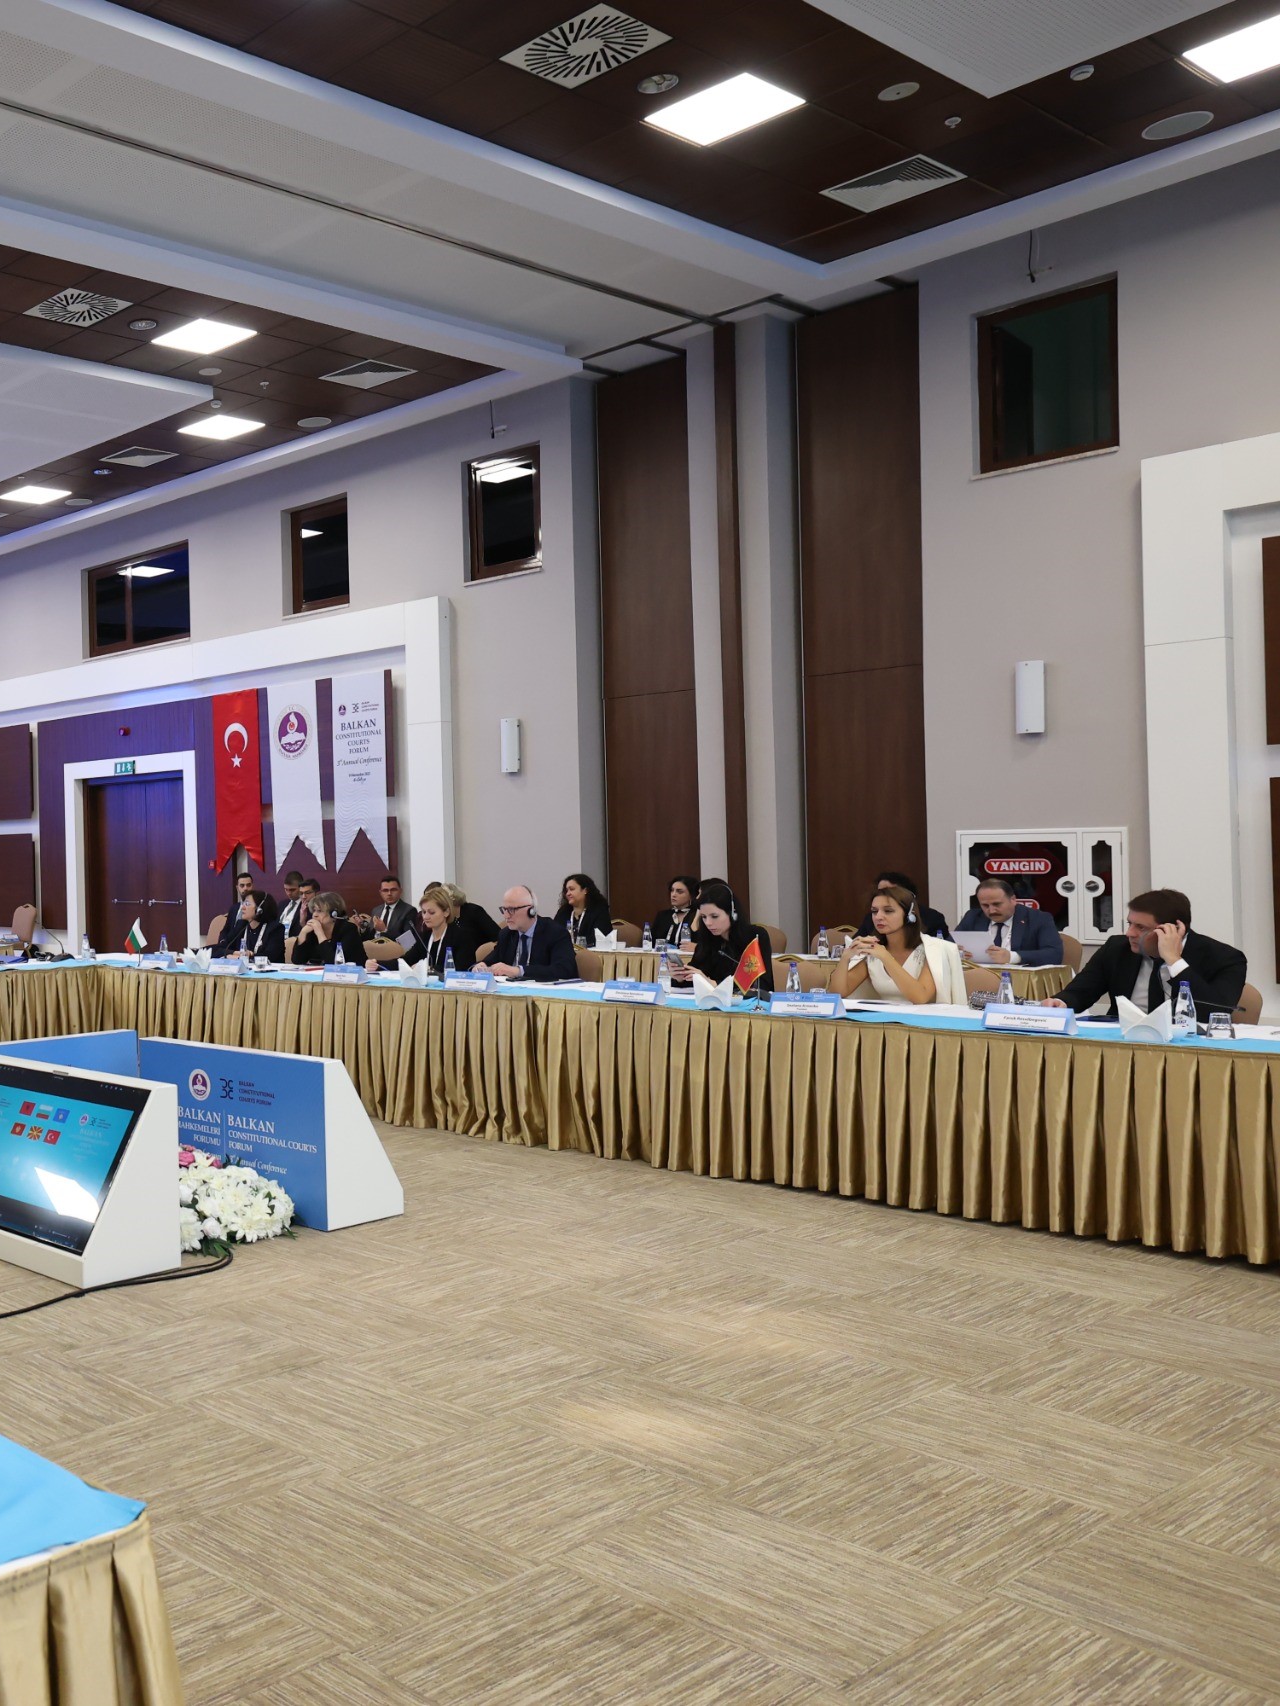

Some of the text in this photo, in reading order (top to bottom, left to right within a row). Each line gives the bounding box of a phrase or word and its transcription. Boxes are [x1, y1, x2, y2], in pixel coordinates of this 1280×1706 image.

[340, 718, 377, 731] BALKAN
[335, 729, 382, 740] CONSTITUTIONAL
[347, 739, 370, 747] COURTS
[990, 861, 1045, 871] YANGIN
[238, 1080, 255, 1088] BALKAN
[238, 1088, 275, 1099] CONSTITUTIONAL
[178, 1106, 222, 1125] BALKAN
[227, 1114, 275, 1134] BALKAN
[193, 1134, 222, 1147] FORUMU
[228, 1130, 318, 1154] CONSTITUTIONAL COURTS
[228, 1140, 253, 1153] FORUM
[257, 1159, 288, 1175] Conference
